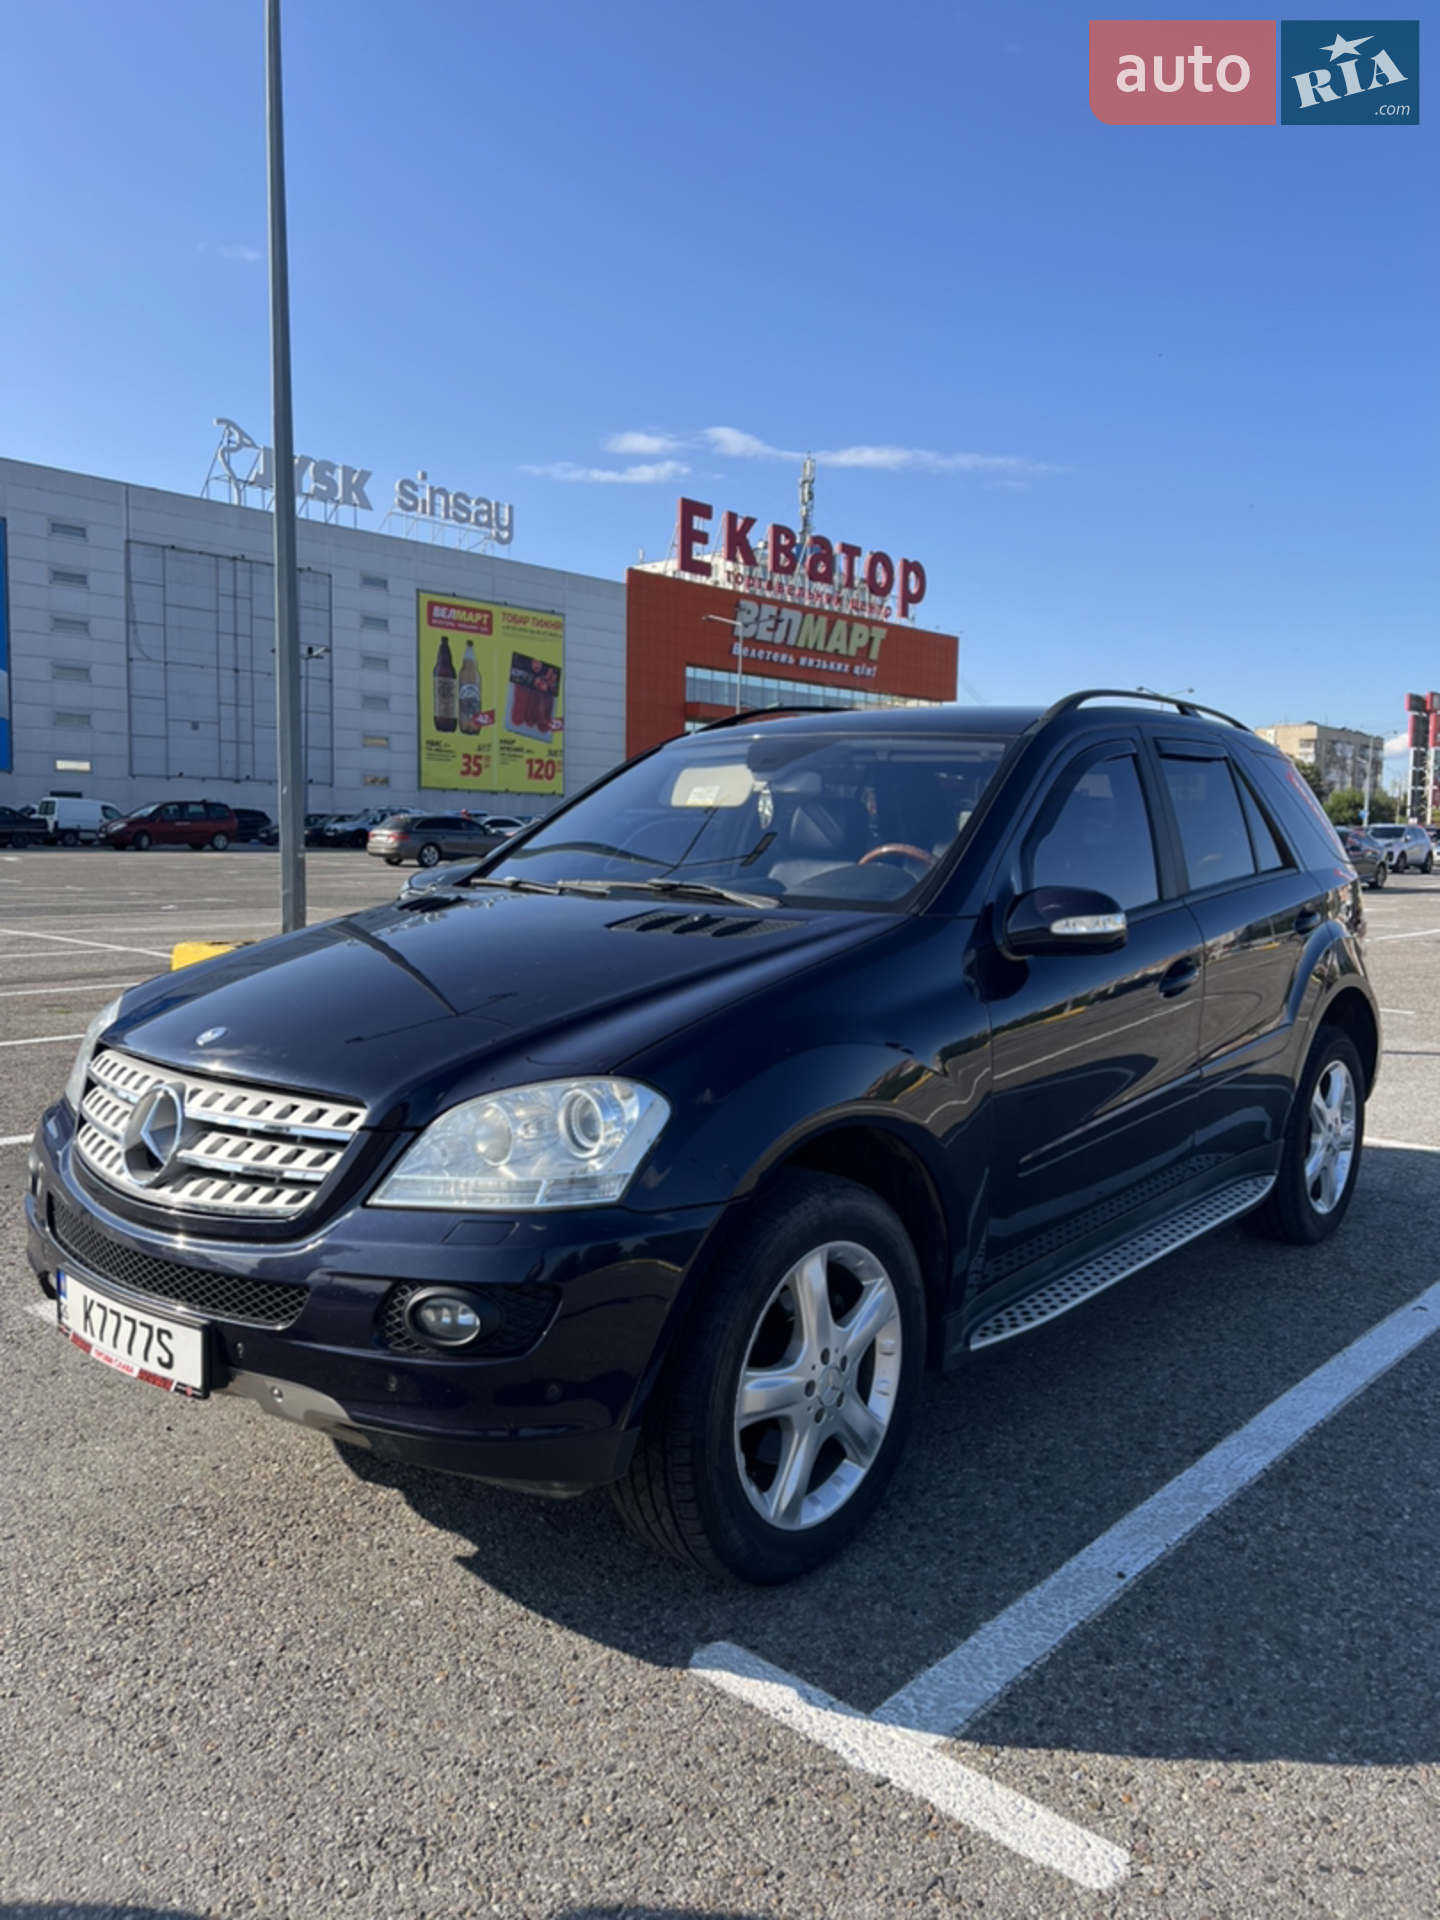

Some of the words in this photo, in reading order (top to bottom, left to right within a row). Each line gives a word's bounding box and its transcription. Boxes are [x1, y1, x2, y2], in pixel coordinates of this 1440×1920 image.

[395, 470, 514, 545] sinsay
[432, 605, 490, 625] ВЕЛМАРТ
[501, 611, 530, 626] ТОВАР
[733, 599, 887, 661] ВЕЛМАРТ
[460, 753, 483, 776] 35
[525, 758, 556, 781] 120
[83, 1294, 174, 1370] K7777S
